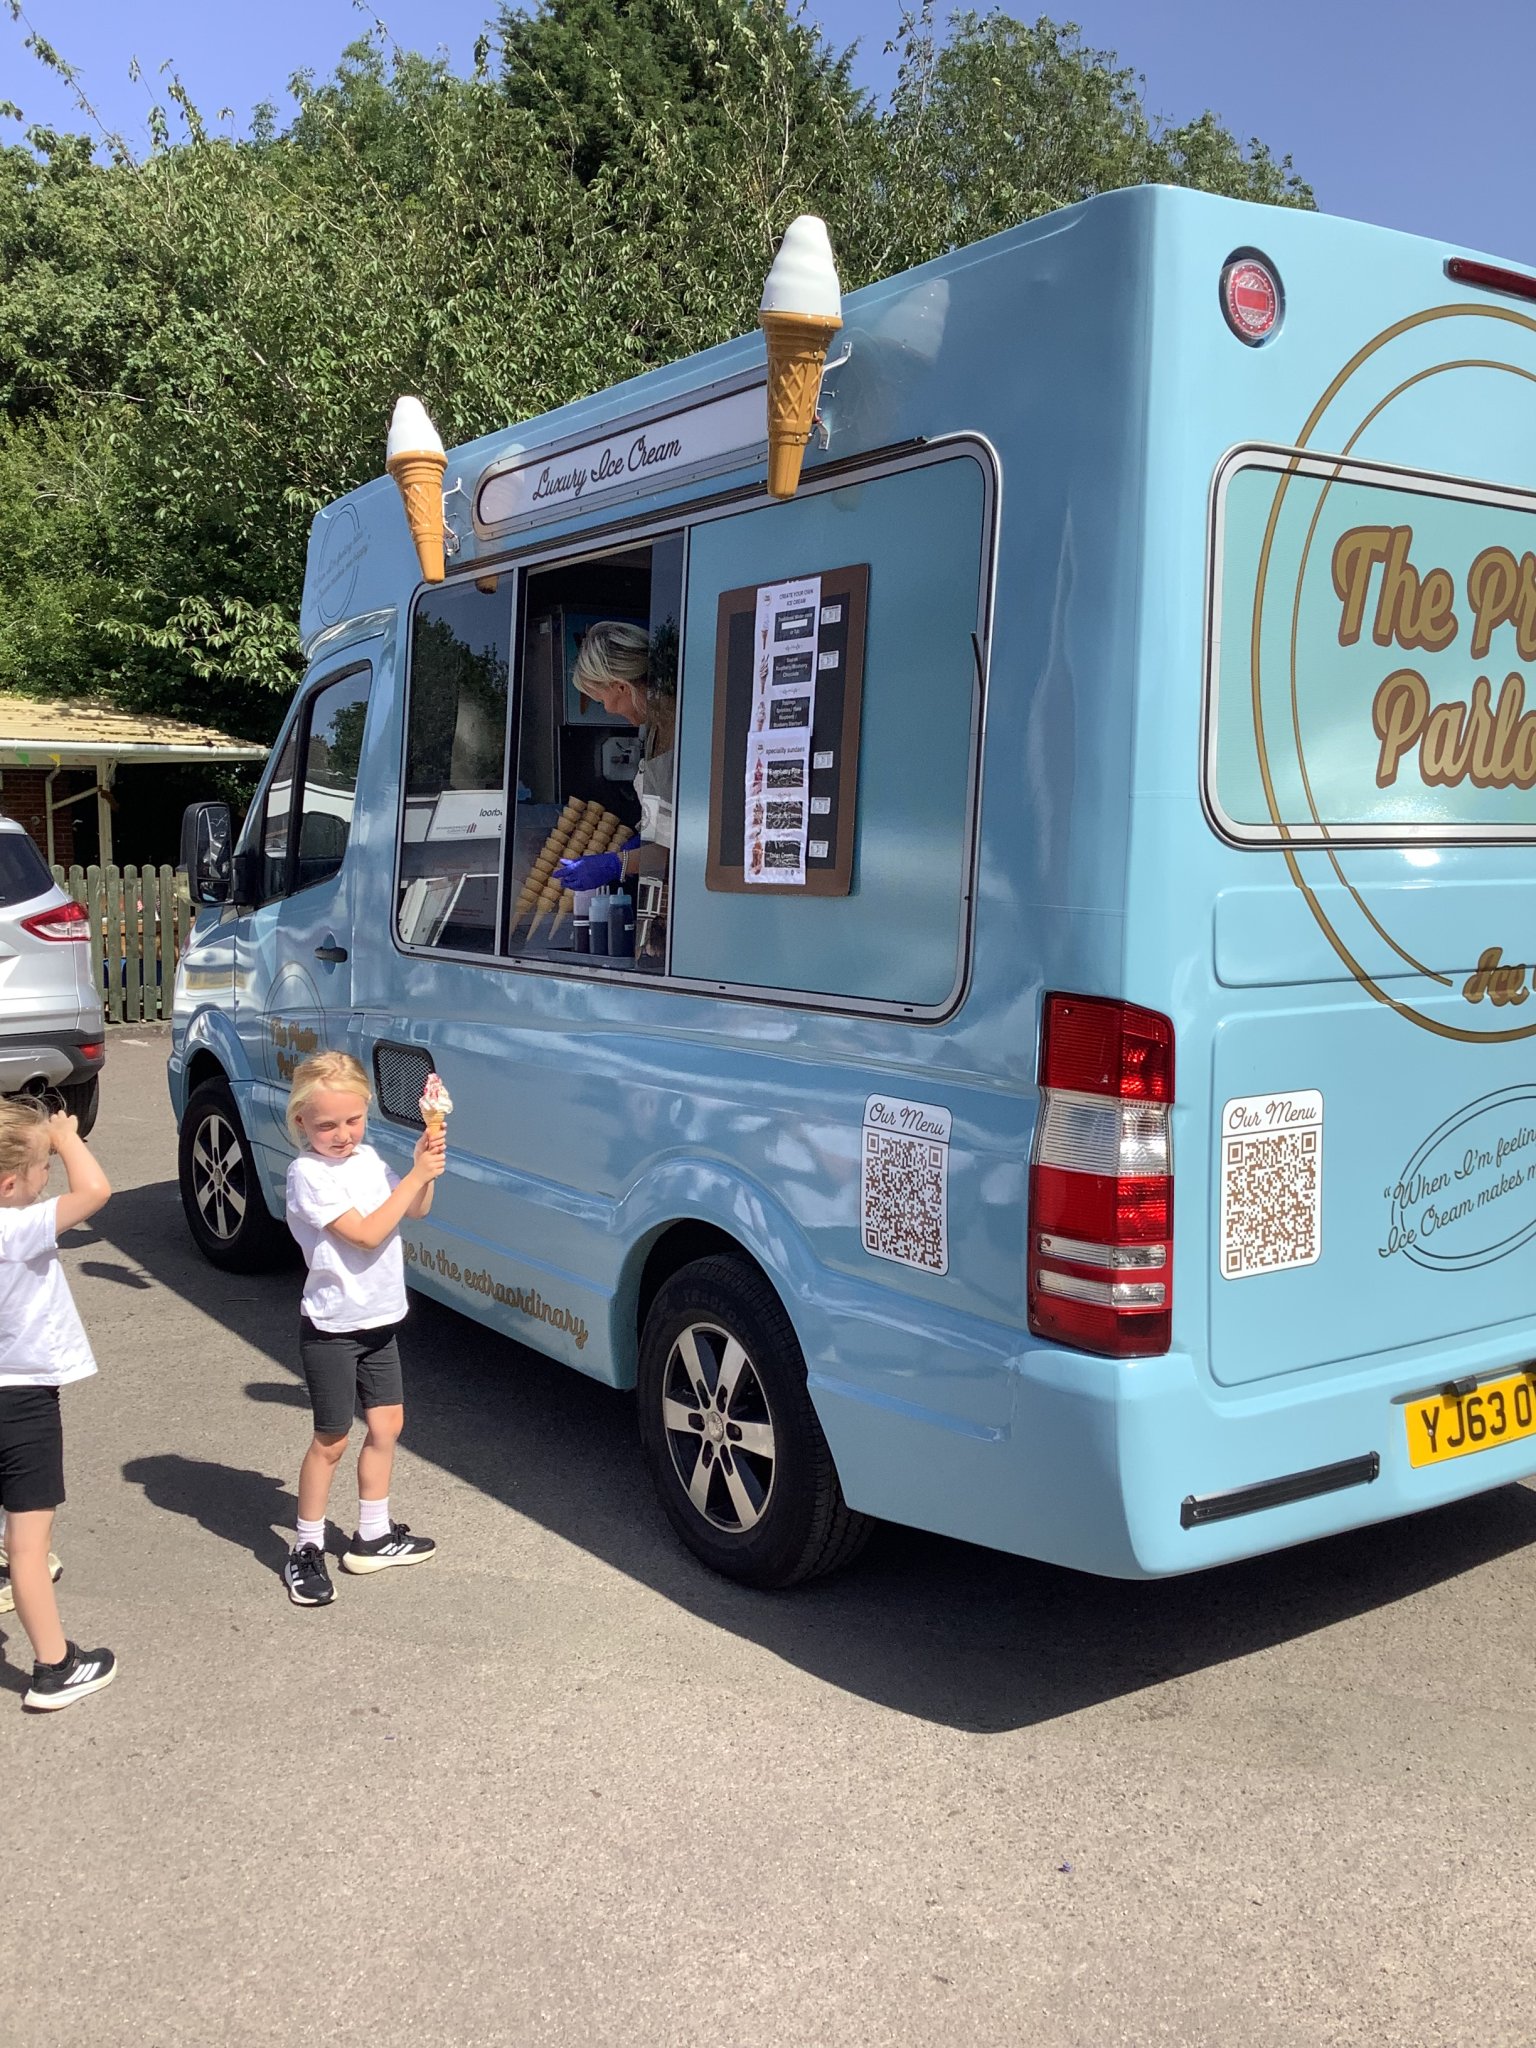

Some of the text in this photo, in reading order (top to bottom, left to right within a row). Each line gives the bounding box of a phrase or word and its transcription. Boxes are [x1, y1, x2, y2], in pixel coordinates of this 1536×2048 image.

[532, 434, 682, 500] Luxury Ice Cream
[1331, 524, 1458, 653] The
[869, 1102, 945, 1135] Our Menu
[1228, 1100, 1317, 1129] Our Menu
[1454, 1149, 1493, 1180] I'm
[1378, 1229, 1417, 1258] Ice
[1420, 1204, 1474, 1237] Cream
[1477, 1169, 1524, 1208] makes
[419, 1241, 436, 1271] in
[436, 1248, 462, 1282] the
[463, 1267, 589, 1350] extraordinary
[1421, 1391, 1507, 1453] YJ63
